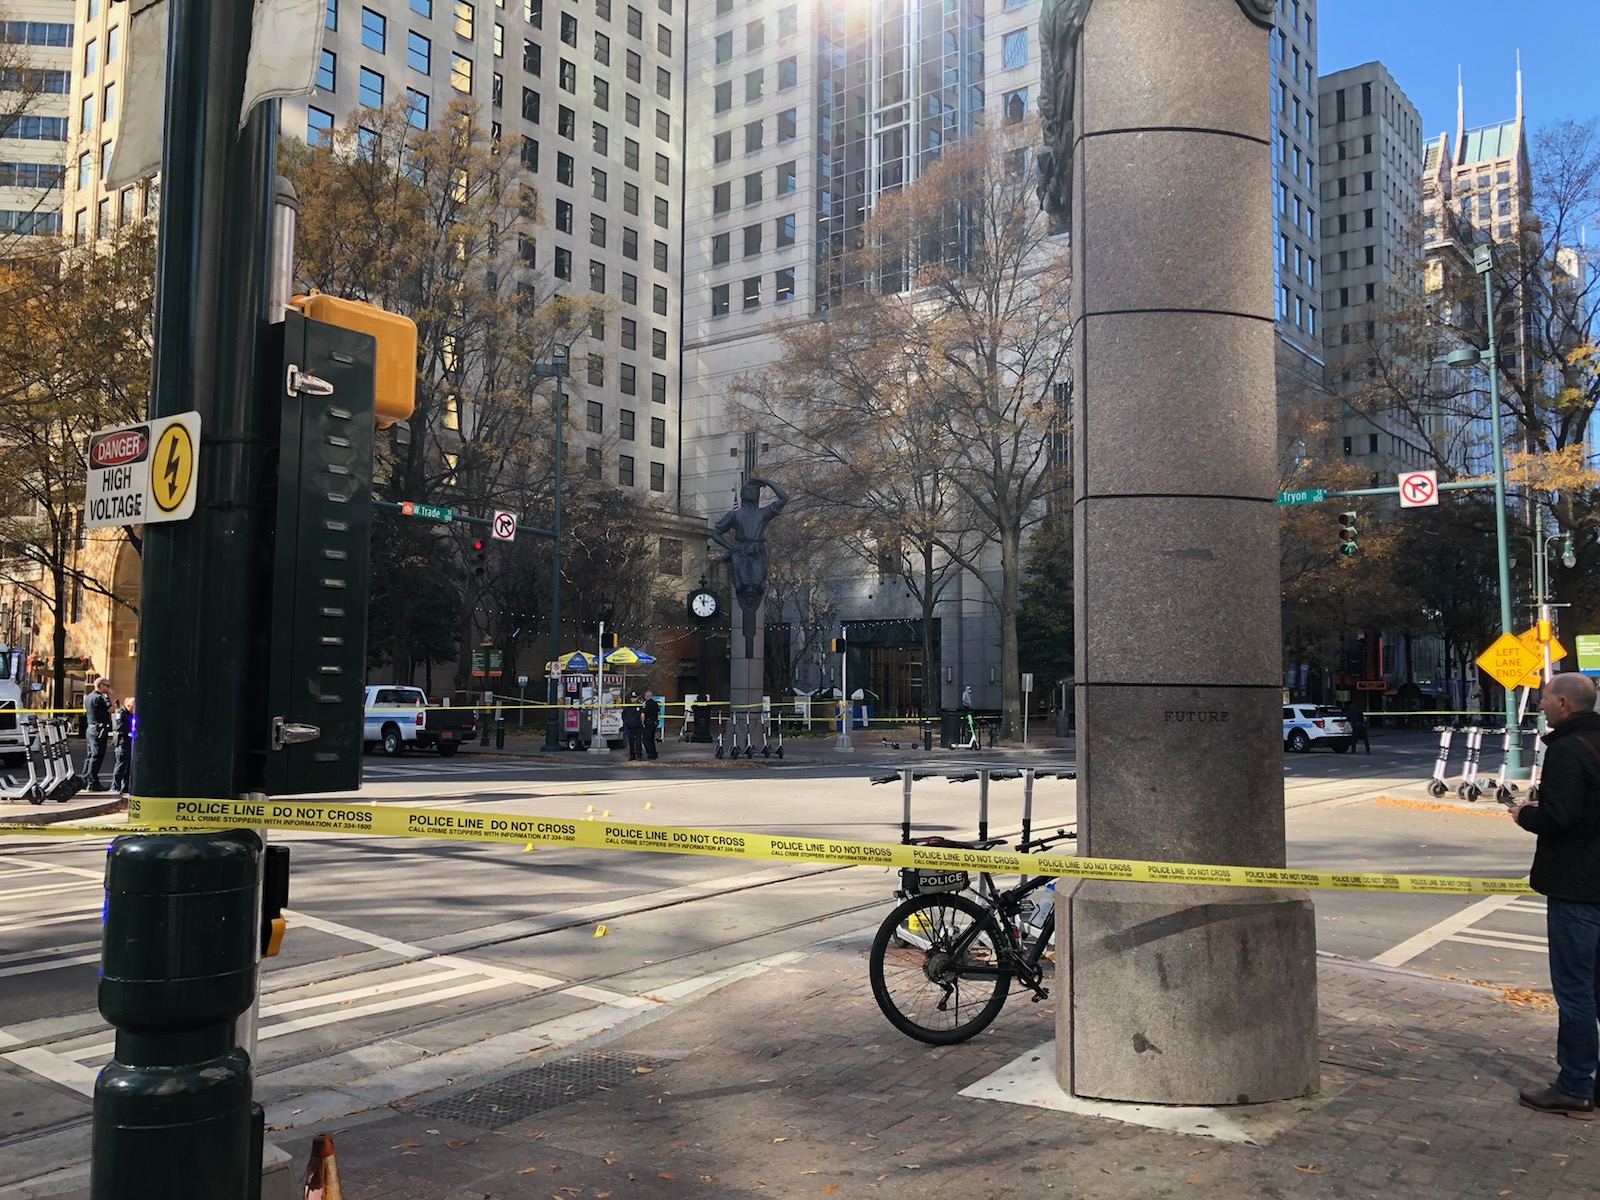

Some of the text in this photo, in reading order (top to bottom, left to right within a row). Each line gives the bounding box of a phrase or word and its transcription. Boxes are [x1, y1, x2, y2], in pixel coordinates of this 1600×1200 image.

[98, 436, 140, 460] DANGER
[102, 466, 132, 492] HIGH
[1283, 492, 1307, 504] Tryon
[90, 493, 142, 521] VOLTAGE
[421, 506, 440, 518] Trade
[1496, 647, 1520, 657] LEFT
[1495, 658, 1522, 667] LANE
[1496, 669, 1523, 678] ENDS
[1164, 711, 1230, 722] FUTURE
[177, 802, 373, 822] POLICE LINE DO NOT CROSS
[223, 816, 262, 824] STOPPERS
[283, 819, 331, 828] INFORMATION
[333, 821, 341, 829] AT
[409, 815, 576, 834] POLICE LINE DO NOT CROSS
[449, 828, 482, 836] STOPPERS
[605, 827, 745, 847] POLICE LINE DO NOT CROSS
[621, 838, 638, 846] CRIME
[771, 840, 892, 856] POLICE LINE DO NOT CROSS
[913, 850, 1019, 865] POLICE LINE DO NOT CROSS
[1038, 858, 1064, 868] POLICE
[1065, 861, 1081, 869] LINE
[1083, 862, 1094, 870] DO
[1109, 863, 1132, 872] CROSS
[1148, 865, 1171, 874] POLICE
[1171, 867, 1185, 875] LINE
[1187, 868, 1196, 876] DO
[1210, 869, 1231, 877] CROSS
[920, 872, 963, 885] POLICE
[1245, 870, 1265, 878] POLICE
[1265, 871, 1278, 879] LINE
[1280, 872, 1288, 880] DO
[1331, 875, 1350, 883] POLICE
